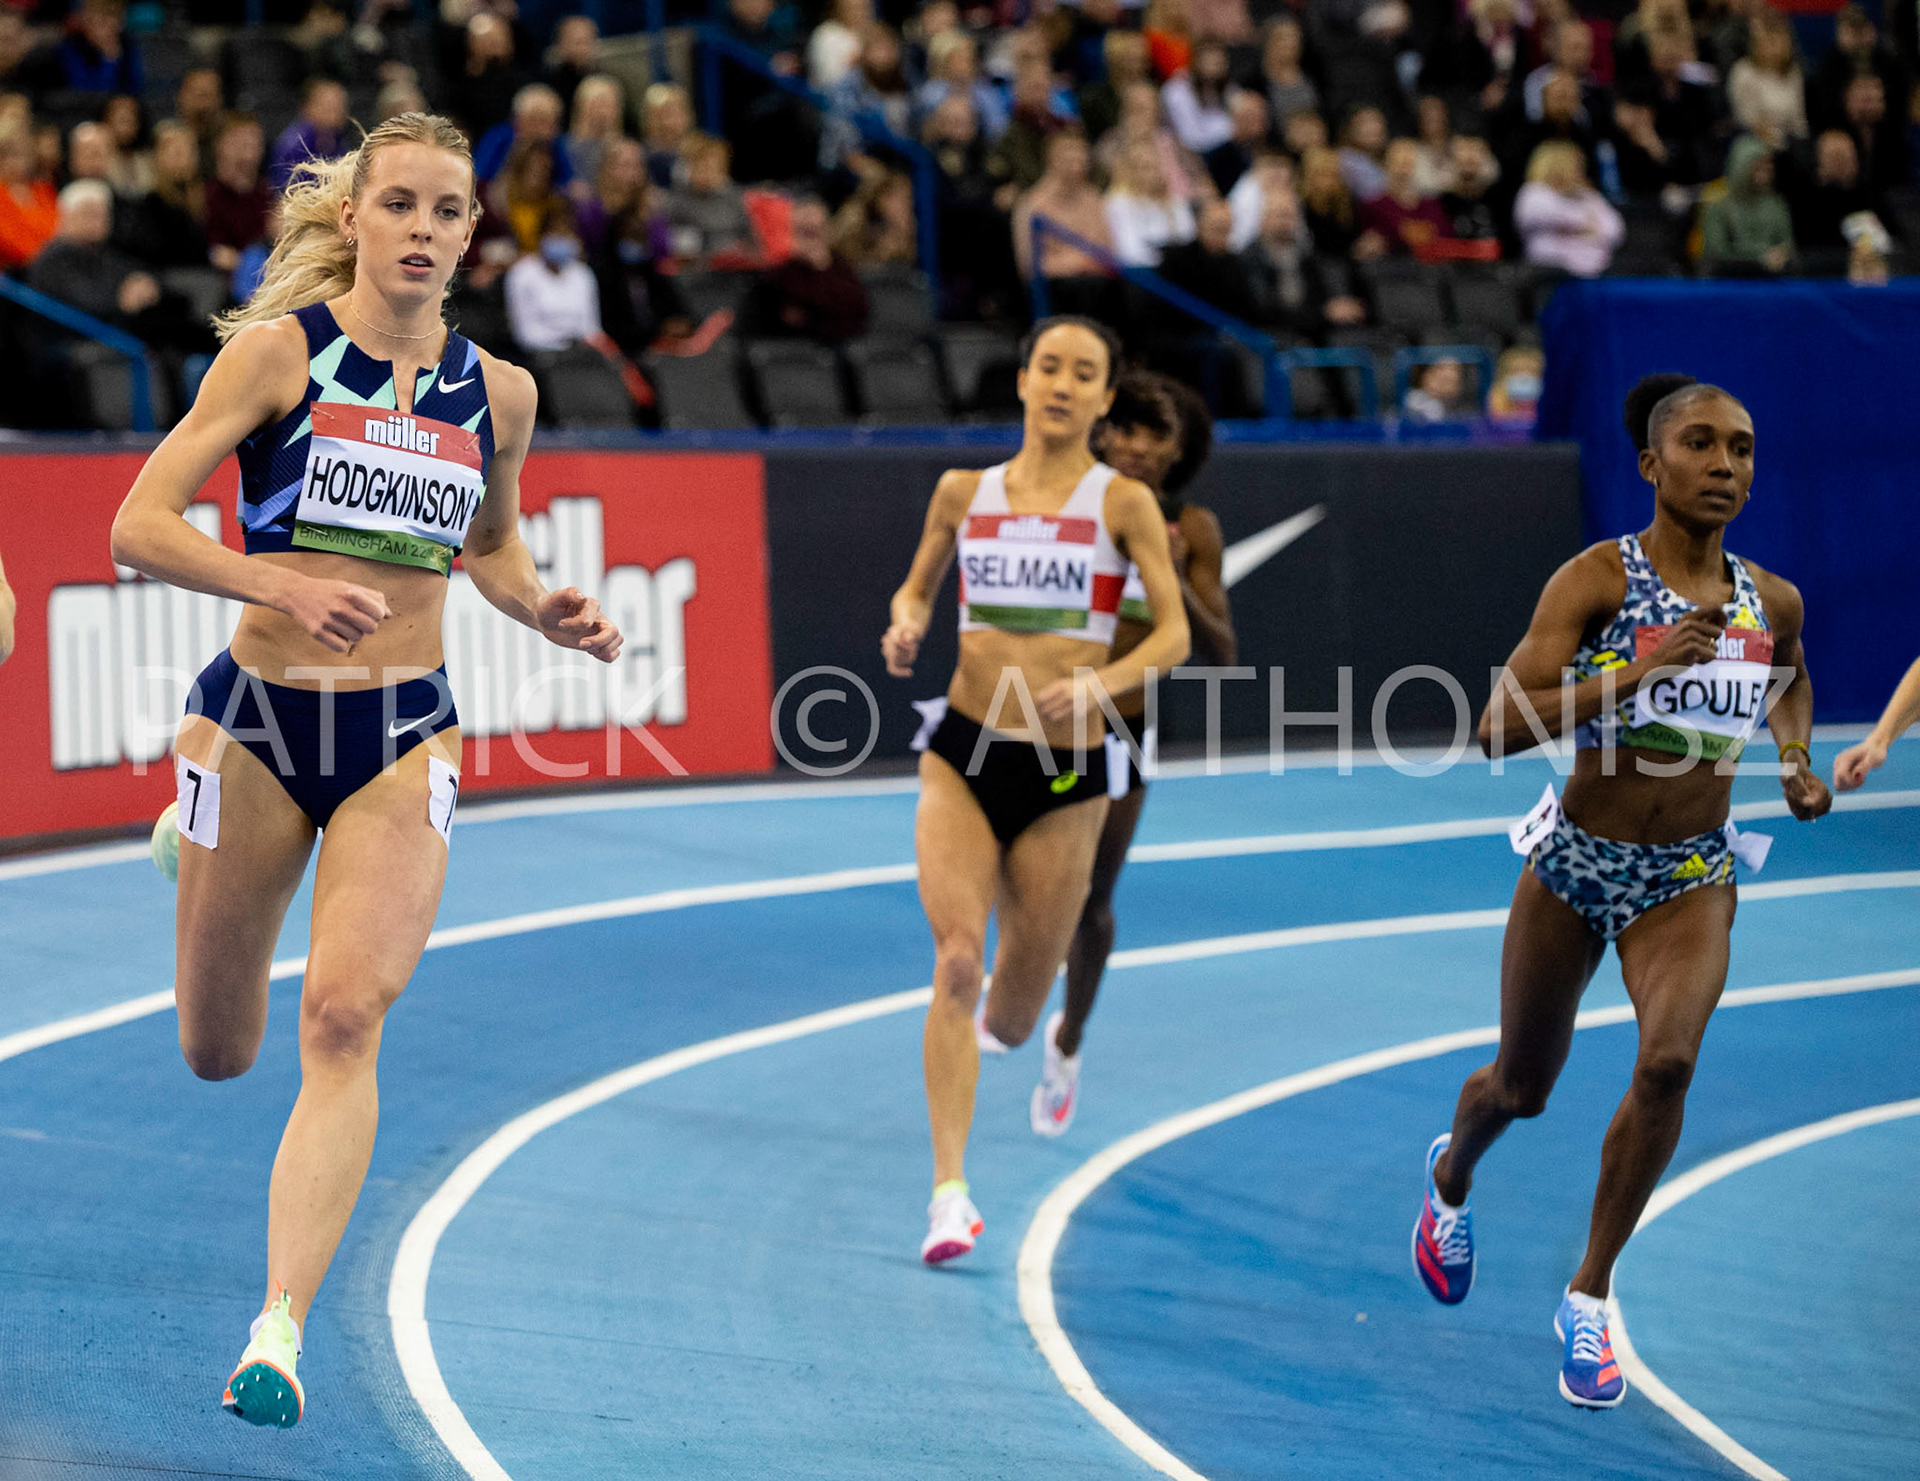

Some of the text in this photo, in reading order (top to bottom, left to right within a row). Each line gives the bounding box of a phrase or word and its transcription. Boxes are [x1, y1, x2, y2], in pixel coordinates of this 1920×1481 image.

[364, 416, 440, 455] müller
[307, 456, 474, 531] HODGKINSON
[299, 527, 428, 559] BIRMINGHAM 22
[965, 555, 1086, 591] SELMAN
[187, 768, 202, 832] 7
